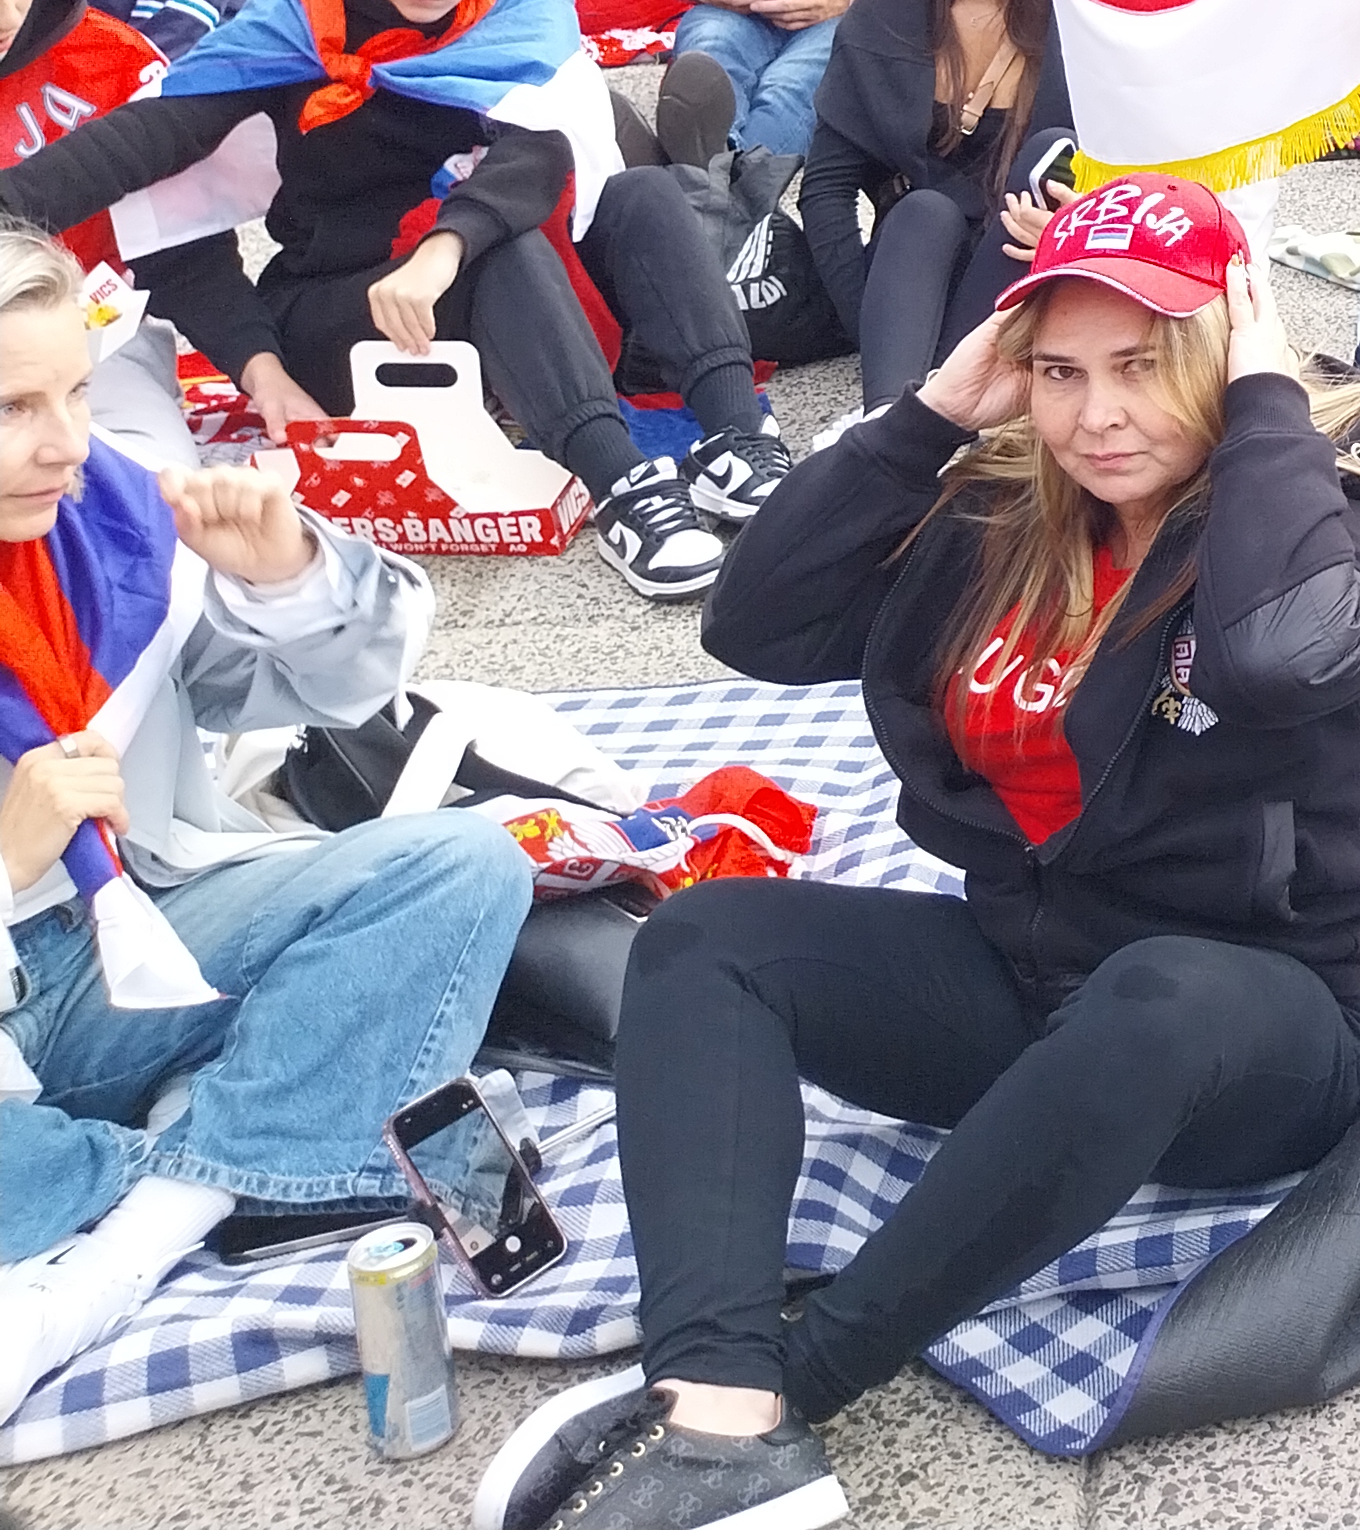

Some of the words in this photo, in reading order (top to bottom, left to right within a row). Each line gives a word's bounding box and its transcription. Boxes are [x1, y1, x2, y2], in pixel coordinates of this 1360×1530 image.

[1053, 183, 1194, 251] SRBIJA
[89, 278, 119, 306] VICS
[441, 543, 499, 553] FORGET
